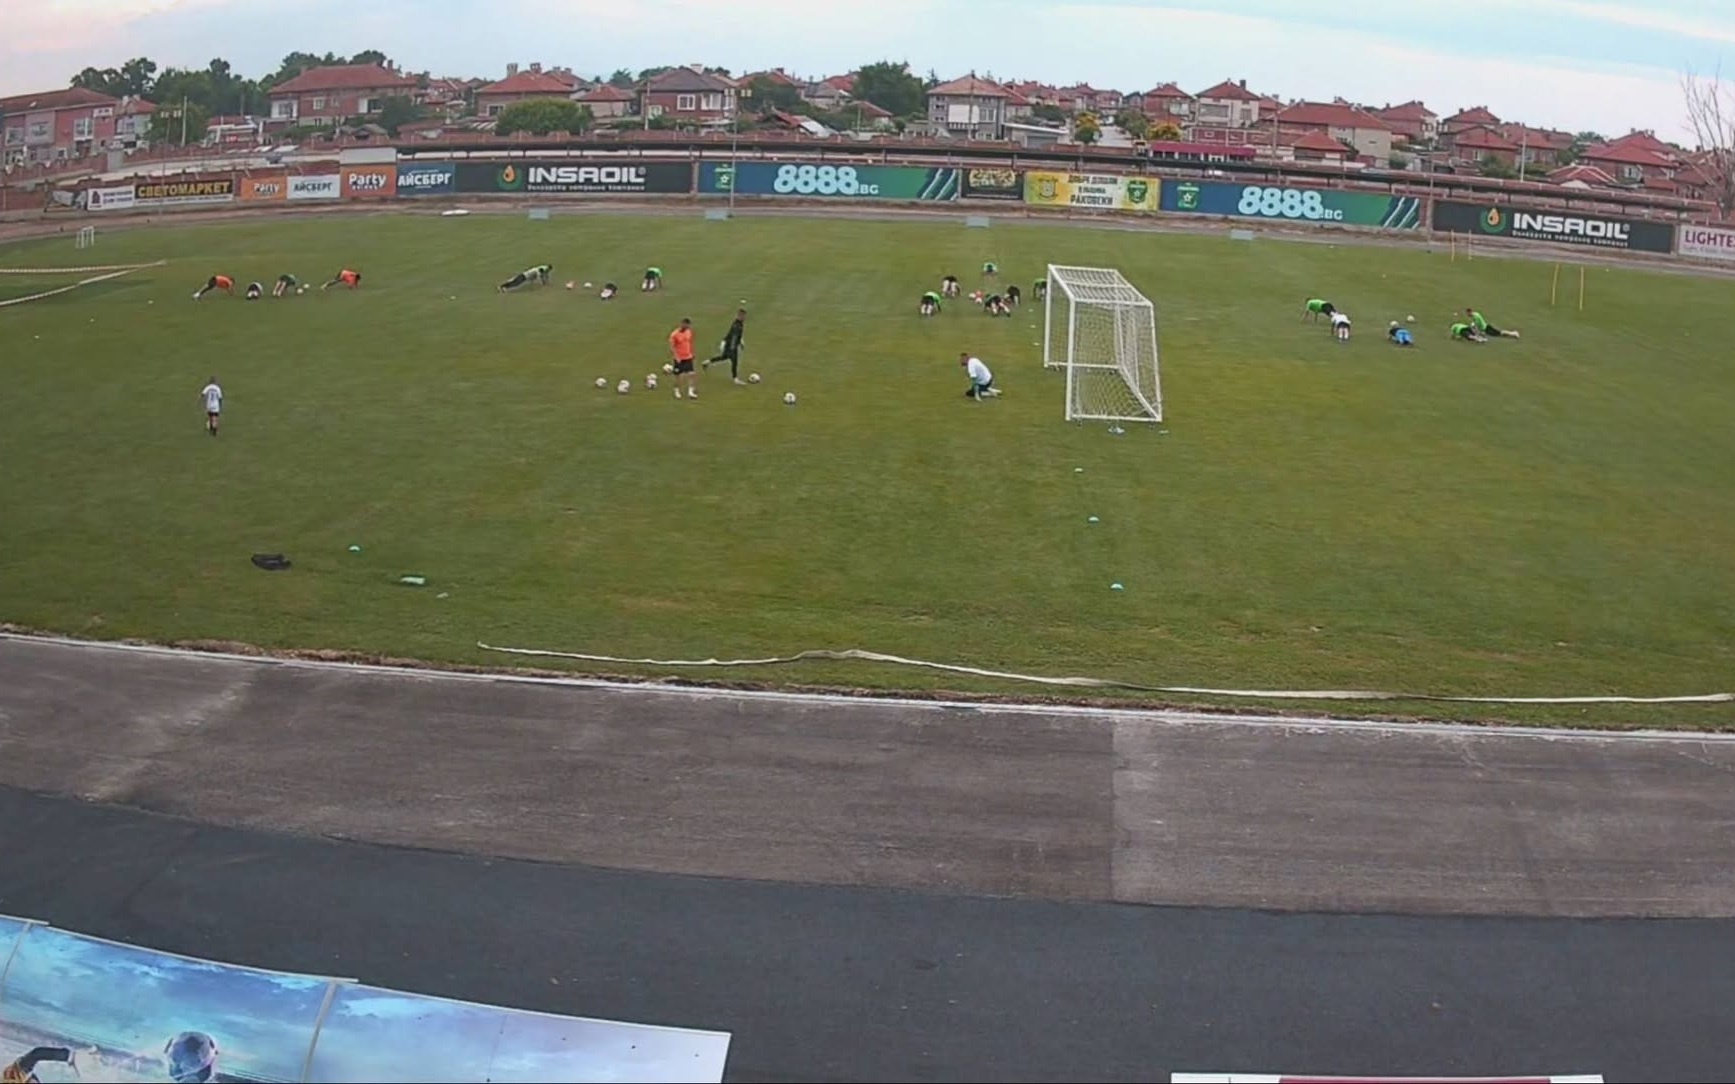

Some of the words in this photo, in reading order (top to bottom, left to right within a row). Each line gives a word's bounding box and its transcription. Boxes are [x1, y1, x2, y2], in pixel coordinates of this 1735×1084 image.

[349, 173, 387, 188] Party
[397, 172, 452, 186] АЙСБЕРГ
[528, 167, 645, 183] INSAOIL
[138, 182, 231, 198] СВЕТОМАРКЕТ
[254, 182, 280, 194] Party
[293, 182, 333, 193] АЙСБЕРГ
[1513, 213, 1629, 239] INSAOIL
